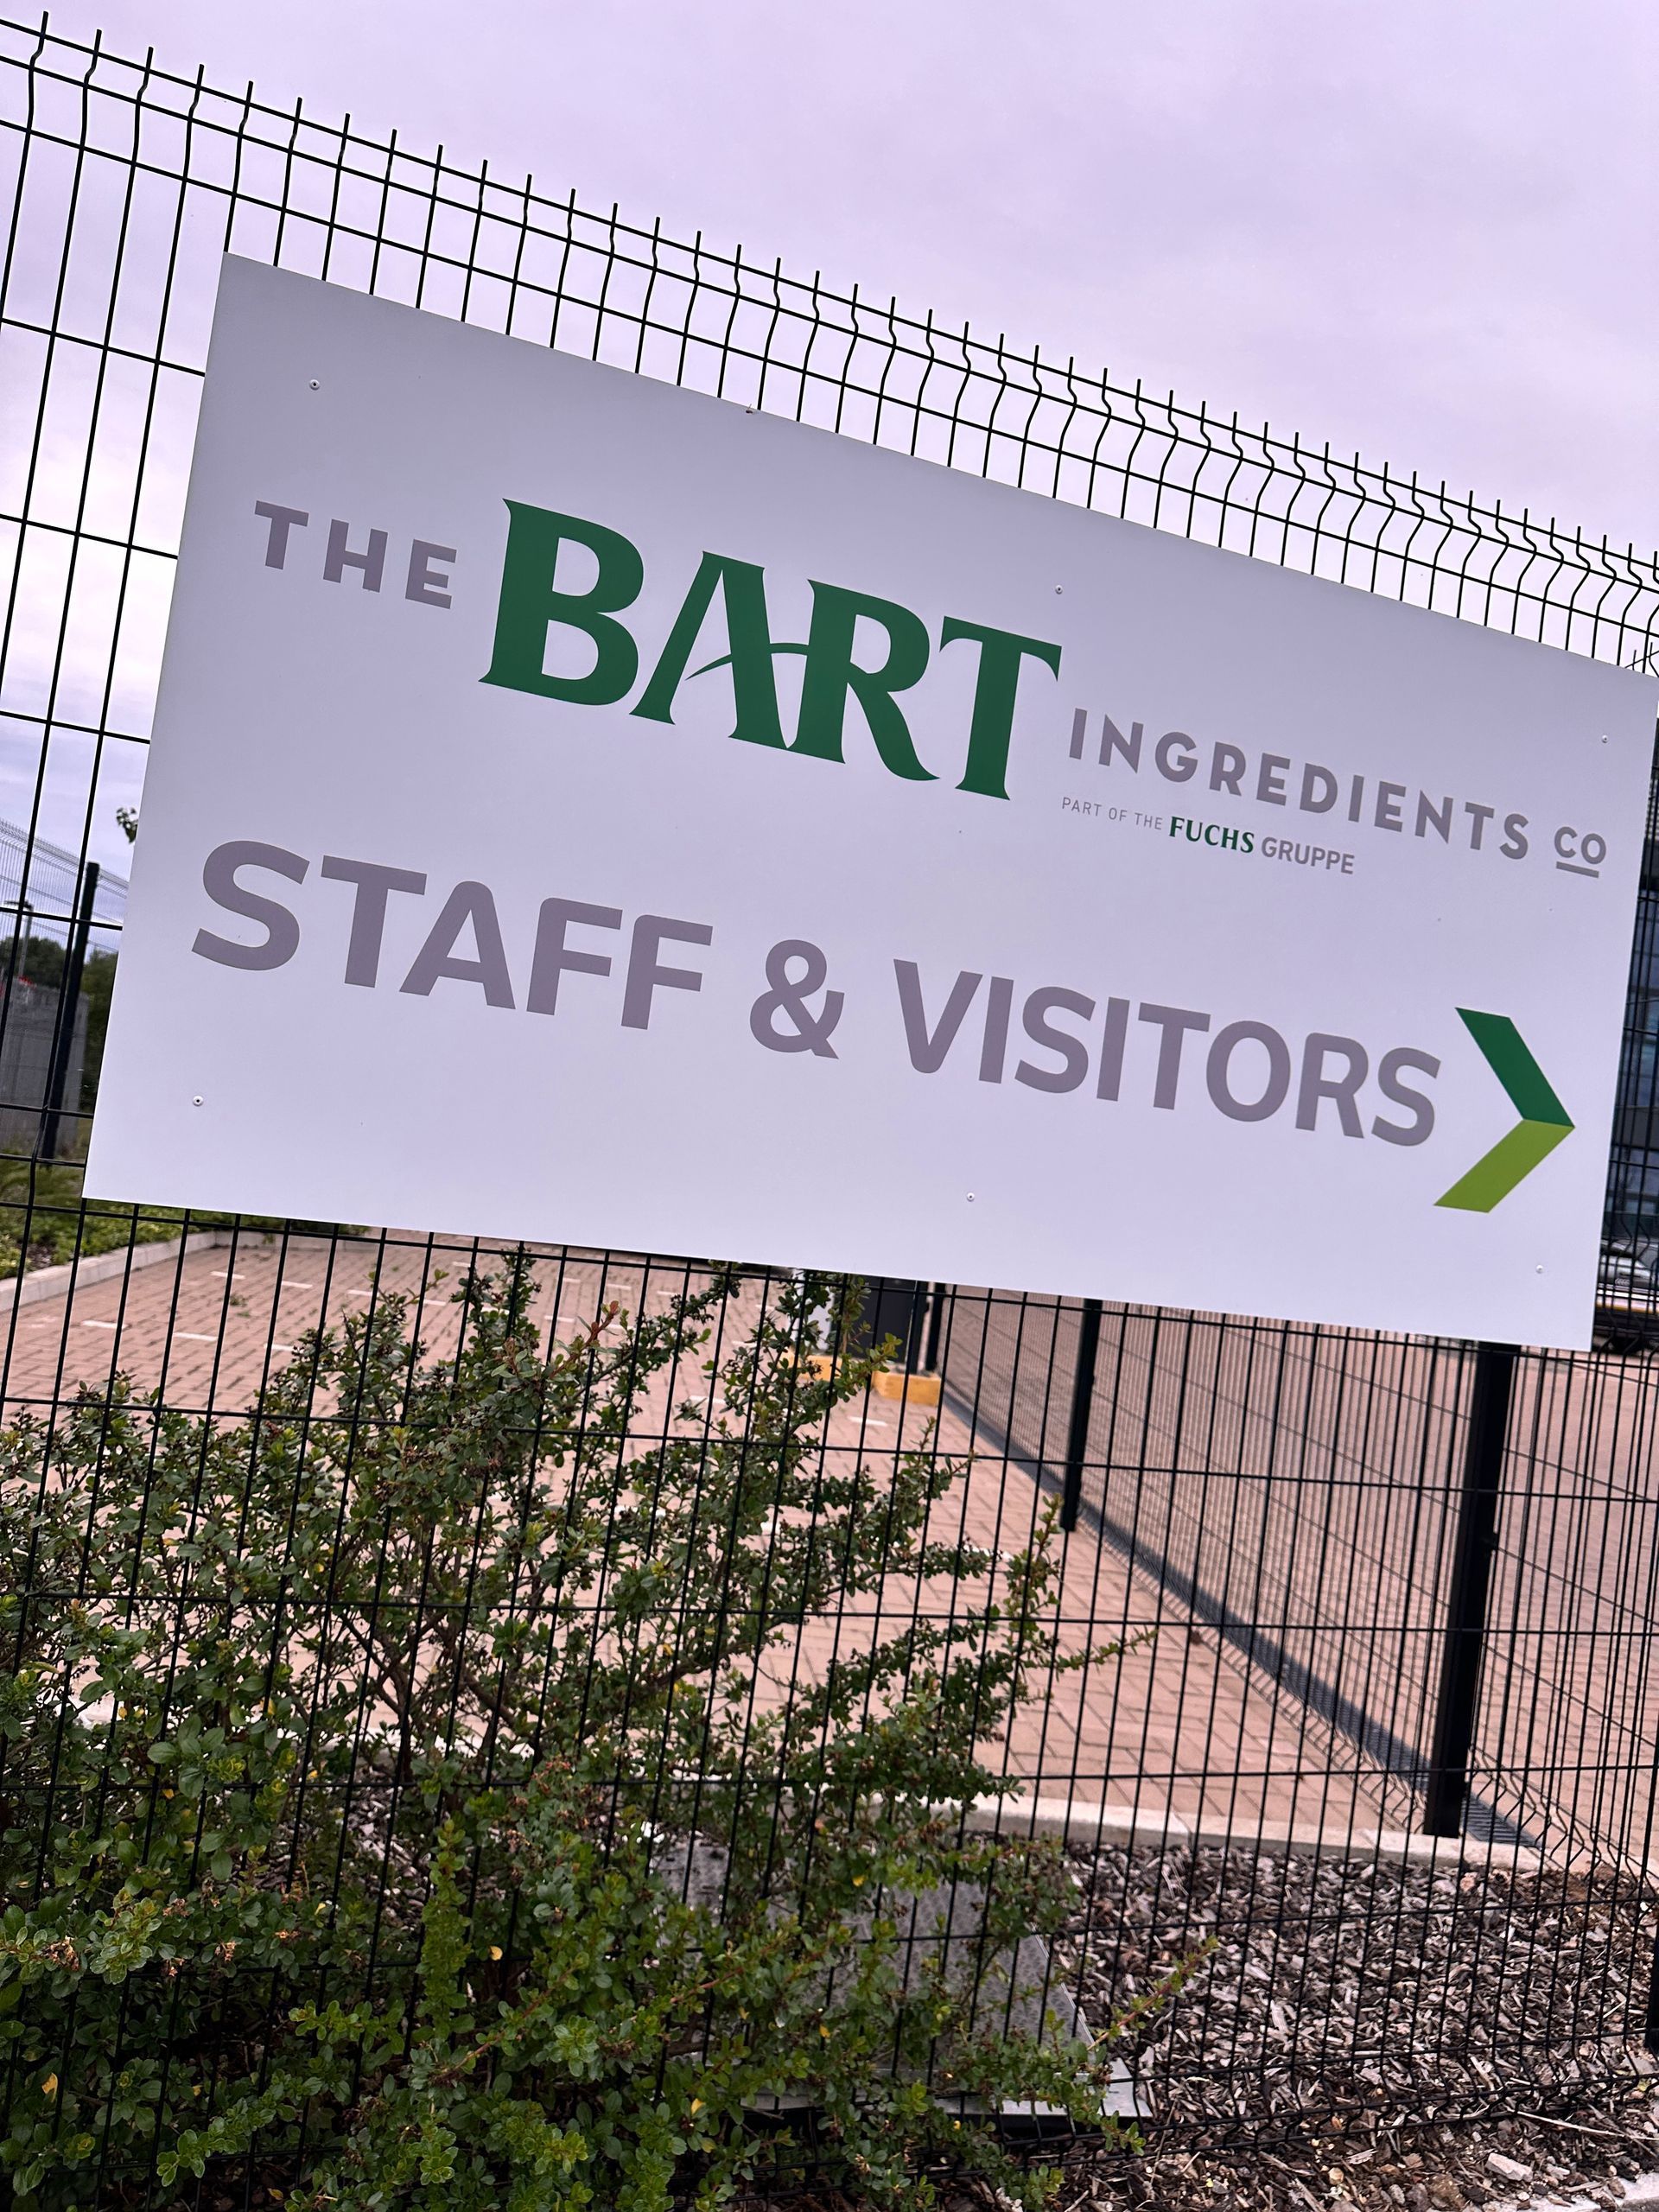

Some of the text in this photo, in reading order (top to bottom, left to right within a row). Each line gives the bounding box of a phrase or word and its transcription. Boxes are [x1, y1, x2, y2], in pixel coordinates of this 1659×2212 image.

[254, 498, 1607, 865] THE BART INGREDIENTS CO
[1062, 797, 1356, 875] PART OF THE FUCHS GRUPPE
[190, 840, 1442, 1147] STAFF & VISITORS
